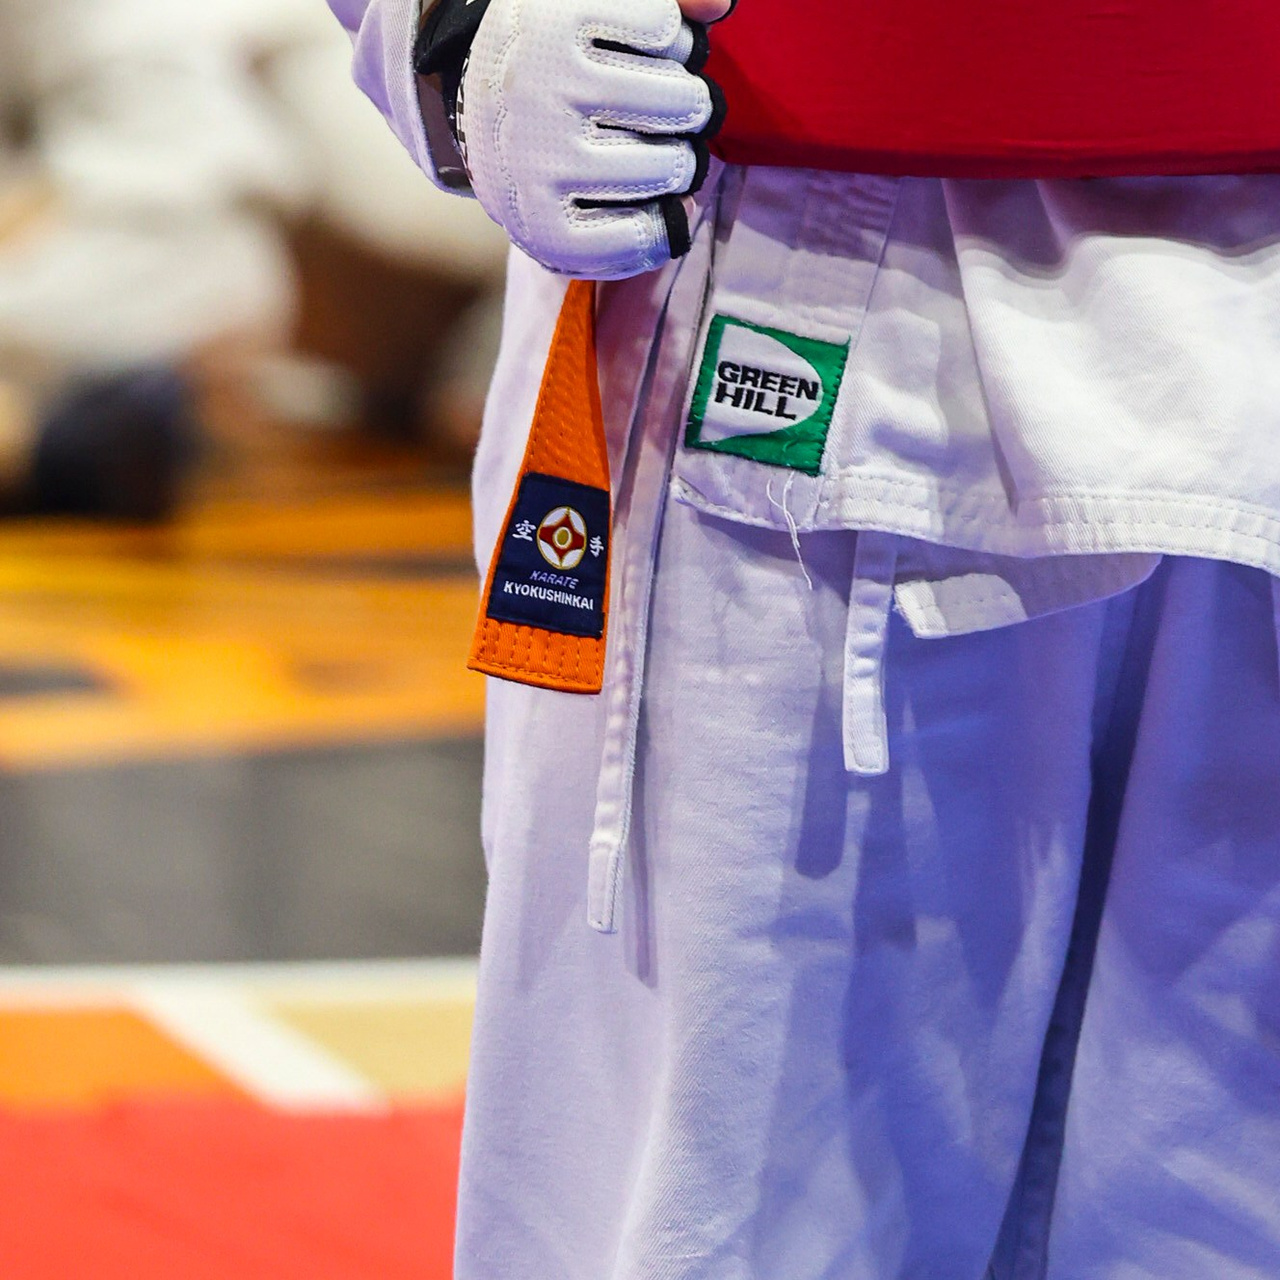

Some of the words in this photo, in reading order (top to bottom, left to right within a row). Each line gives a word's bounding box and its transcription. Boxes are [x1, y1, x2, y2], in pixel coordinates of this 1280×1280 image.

[718, 361, 818, 401] GREEN
[714, 383, 796, 420] HILL
[512, 520, 537, 542] 空
[589, 535, 605, 558] 手
[503, 580, 594, 611] KYOKUSHINKAI
[529, 570, 579, 590] KARATE
